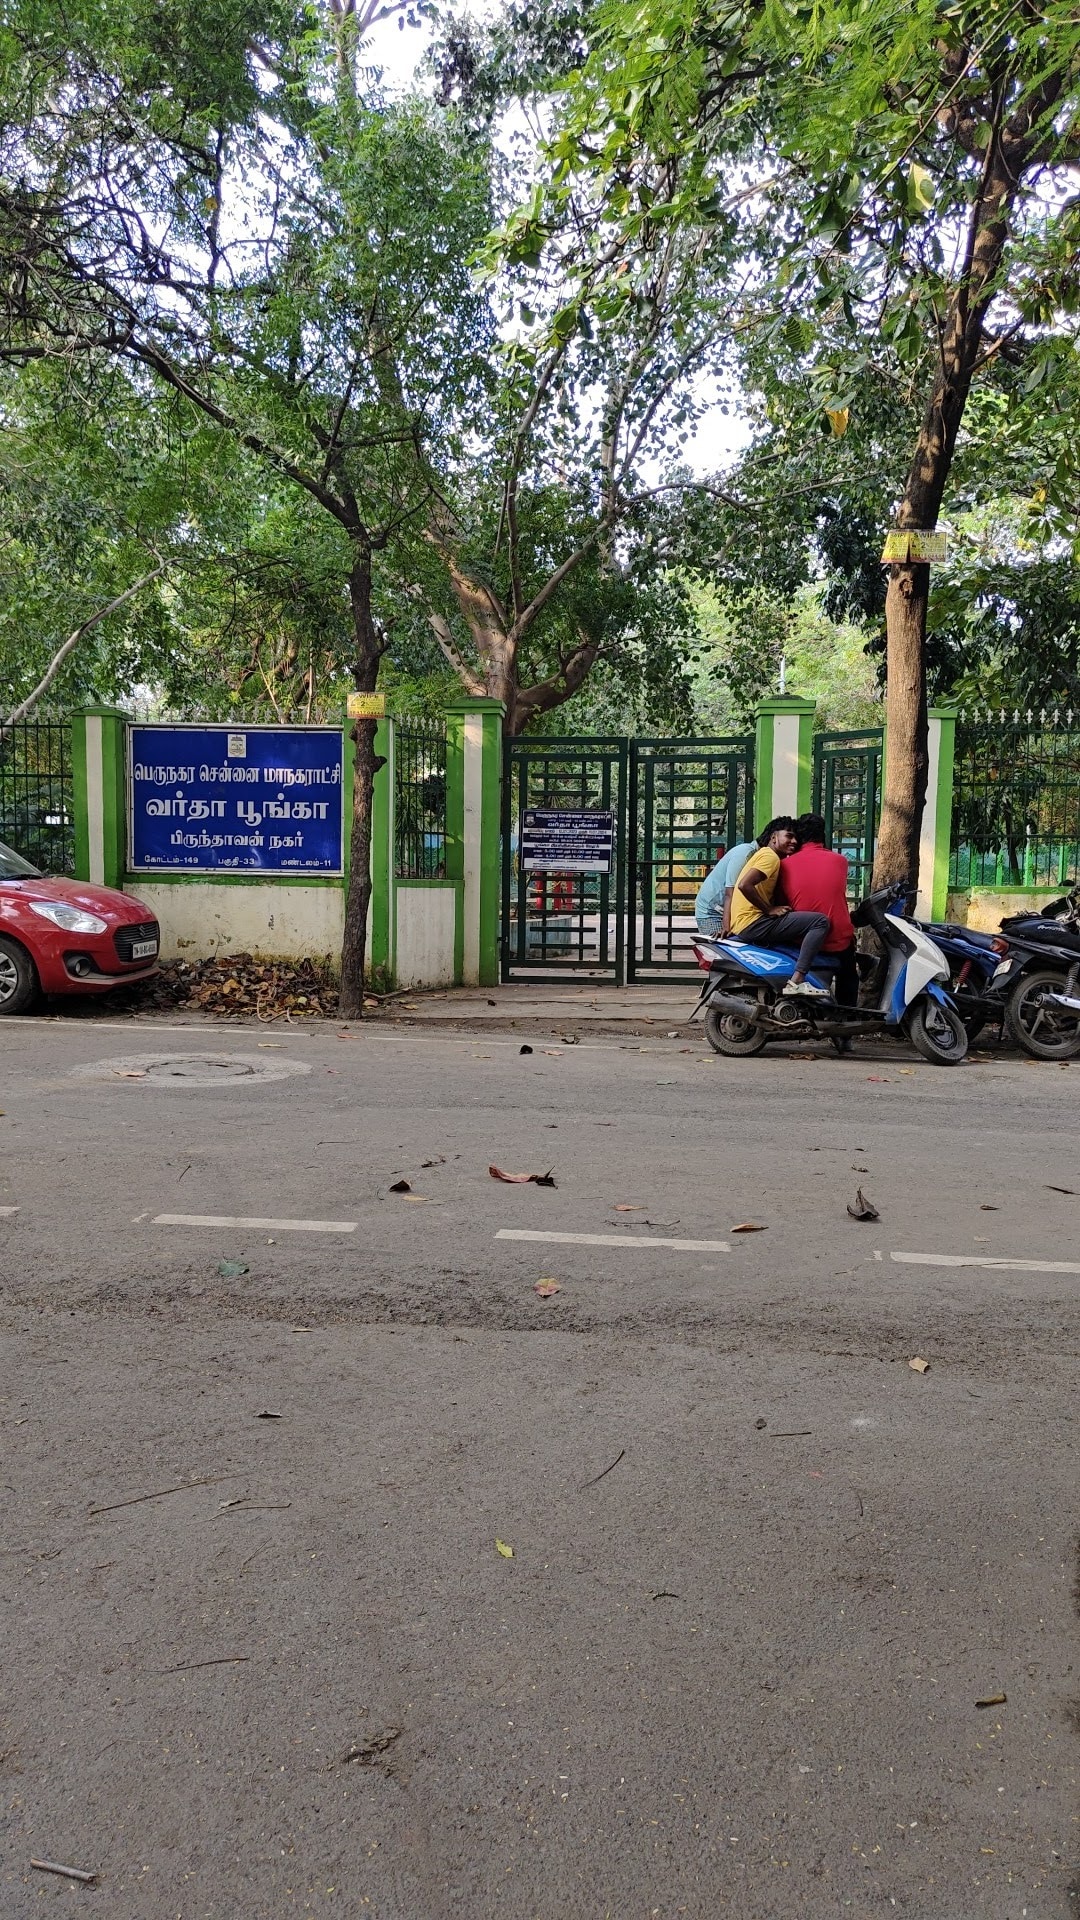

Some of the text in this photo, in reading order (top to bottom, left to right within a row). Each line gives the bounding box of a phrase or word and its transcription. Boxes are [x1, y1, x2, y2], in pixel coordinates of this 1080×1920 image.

[134, 760, 341, 788] பெருநகர சென்னை மாநகராட்சி
[146, 790, 329, 827] வர்தா பூங்கா
[170, 828, 304, 850] பிருந்தாவன் நகர்
